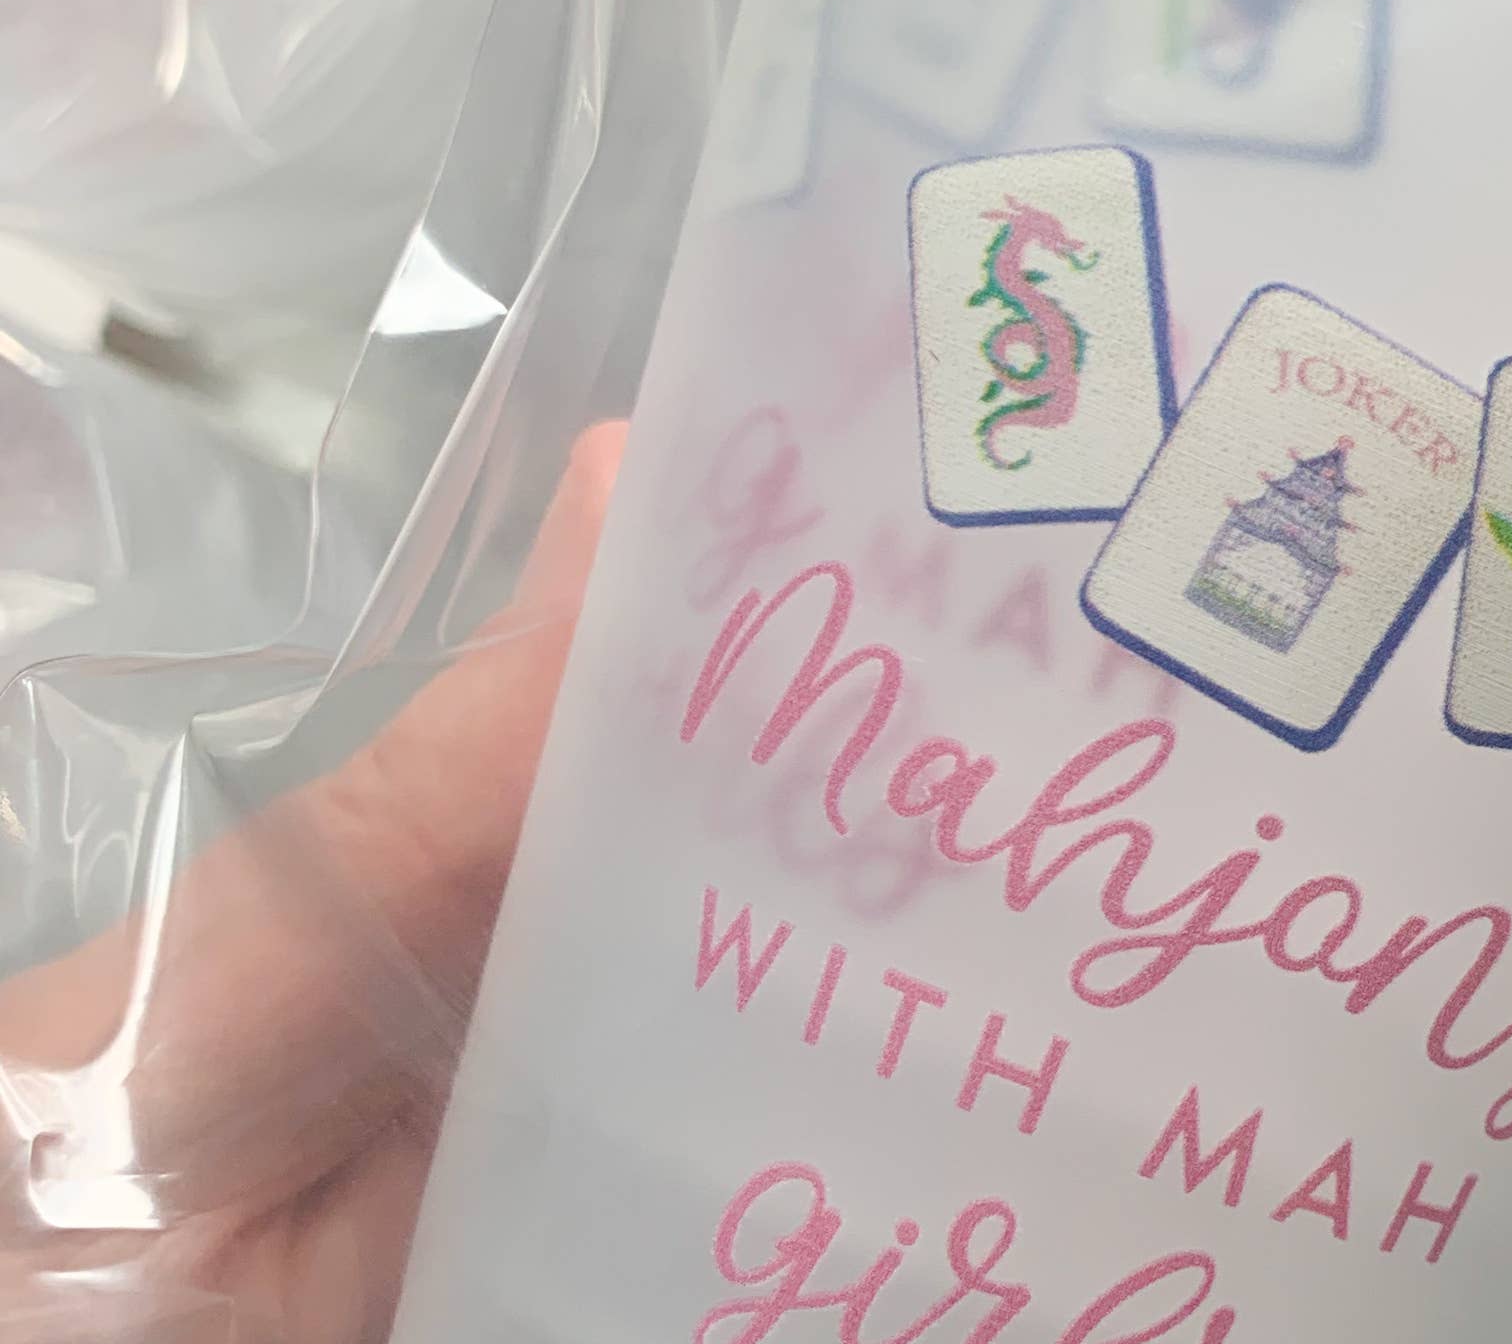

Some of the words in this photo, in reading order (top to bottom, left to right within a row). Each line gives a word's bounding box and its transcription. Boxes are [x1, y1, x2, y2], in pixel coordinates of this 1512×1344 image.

[1262, 348, 1460, 478] JOKER
[695, 886, 1070, 1135] WITH
[1137, 1085, 1480, 1263] MAH
